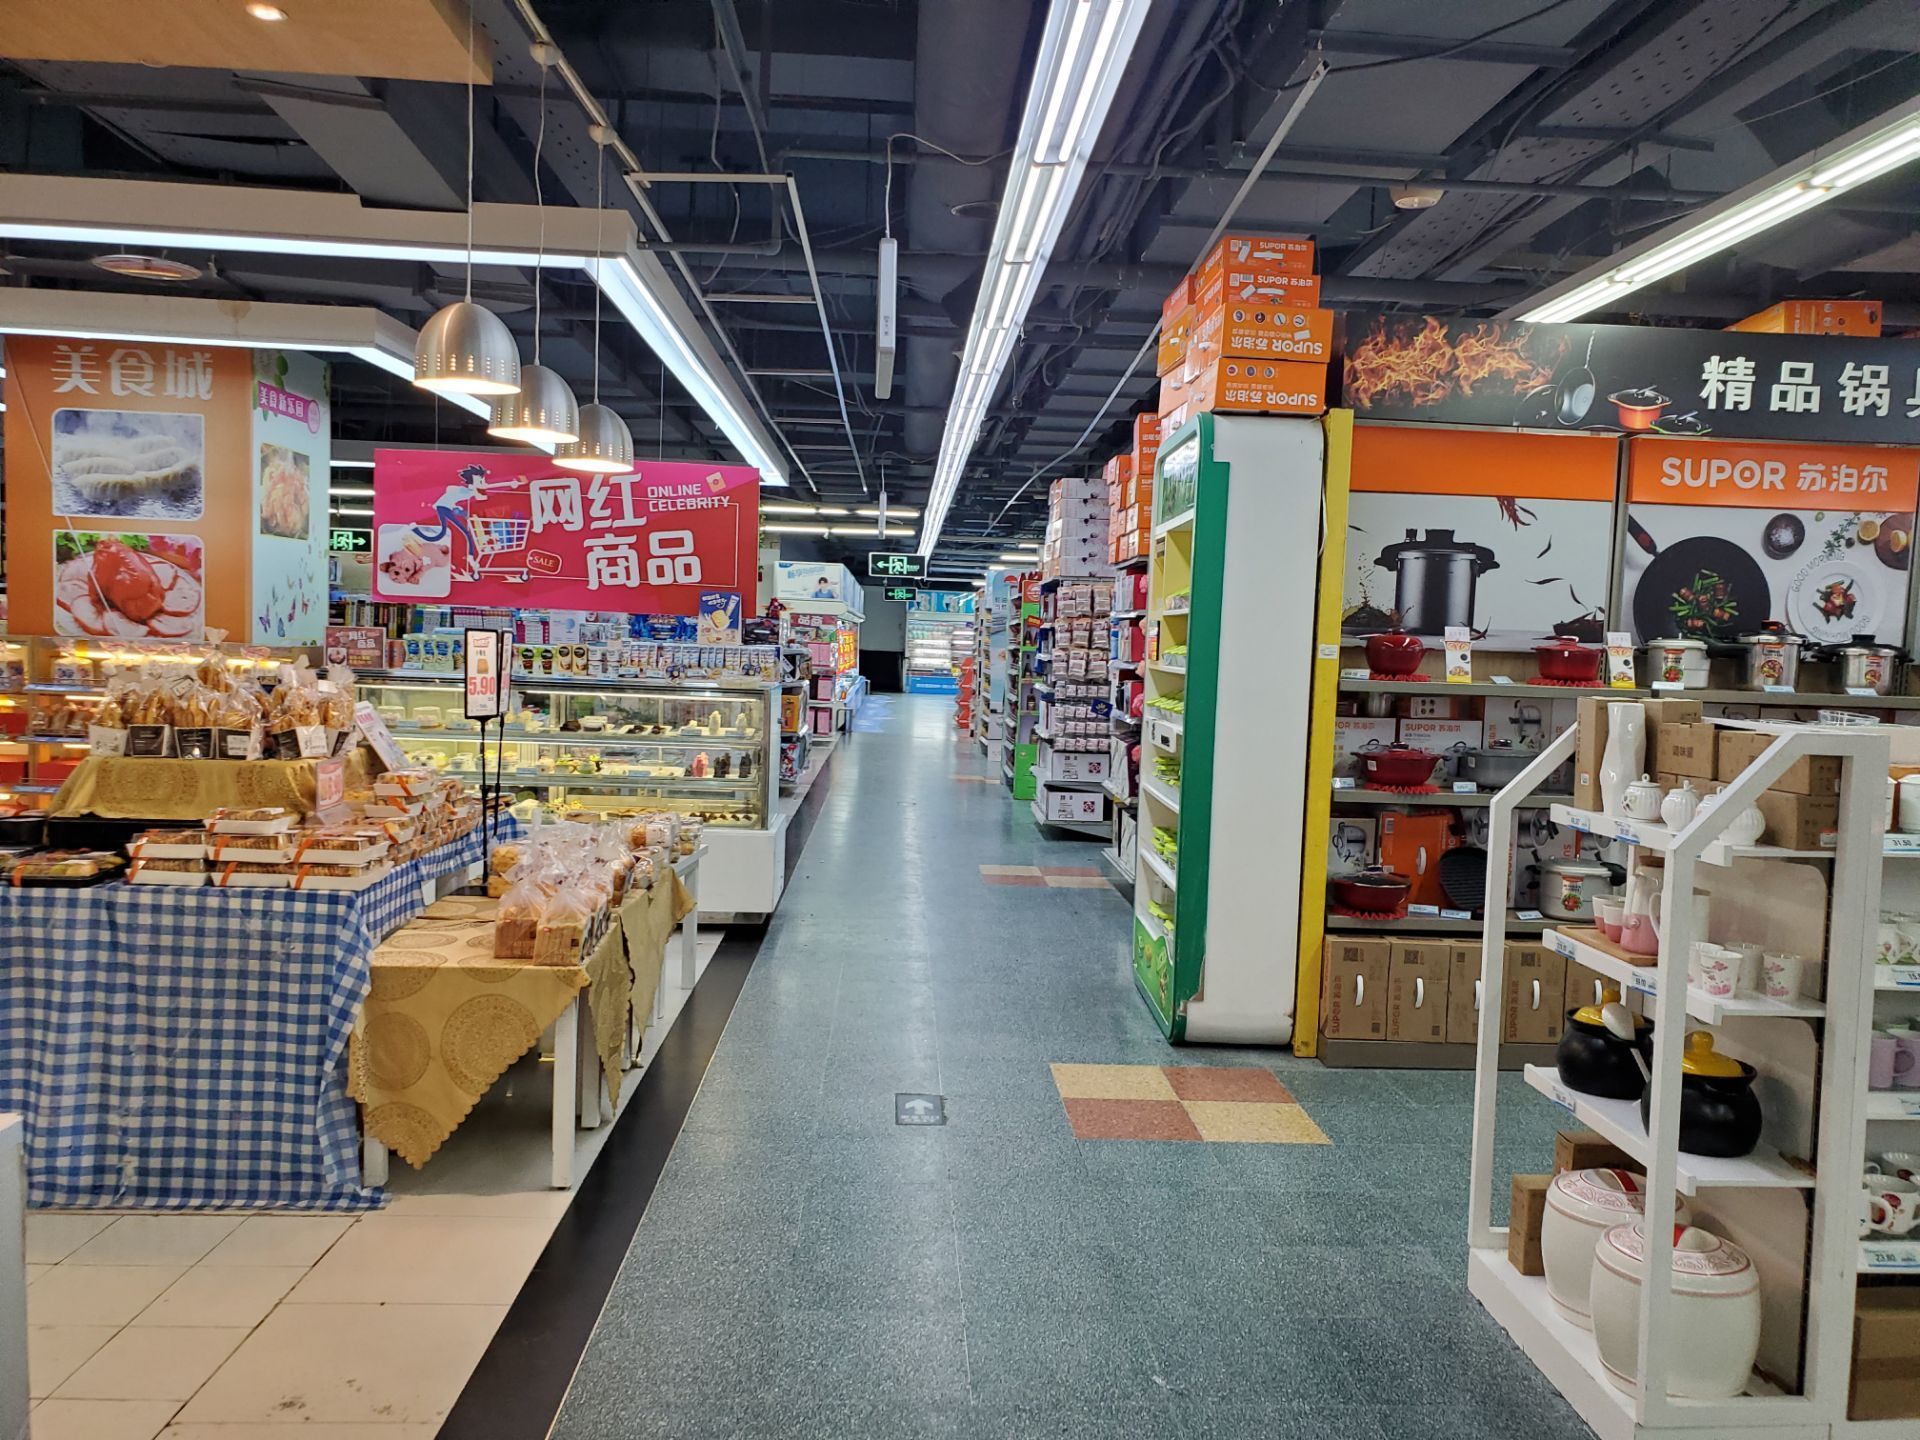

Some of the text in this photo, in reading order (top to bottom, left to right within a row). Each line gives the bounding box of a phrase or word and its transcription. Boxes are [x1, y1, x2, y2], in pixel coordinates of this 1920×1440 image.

[1257, 275, 1289, 285] SUPOR
[1272, 339, 1323, 355] SUPOR
[51, 345, 214, 400] 美食城
[1266, 391, 1317, 406] SUPOR
[1660, 456, 1889, 493] SUPOR 苏泊尔
[647, 482, 702, 499] ONLINE
[529, 472, 648, 534] 网红
[648, 495, 731, 513] CELEBRITY
[531, 554, 556, 568] SALE
[583, 529, 702, 591] 商品
[468, 676, 496, 696] 5.90
[1405, 723, 1436, 732] SUPOR
